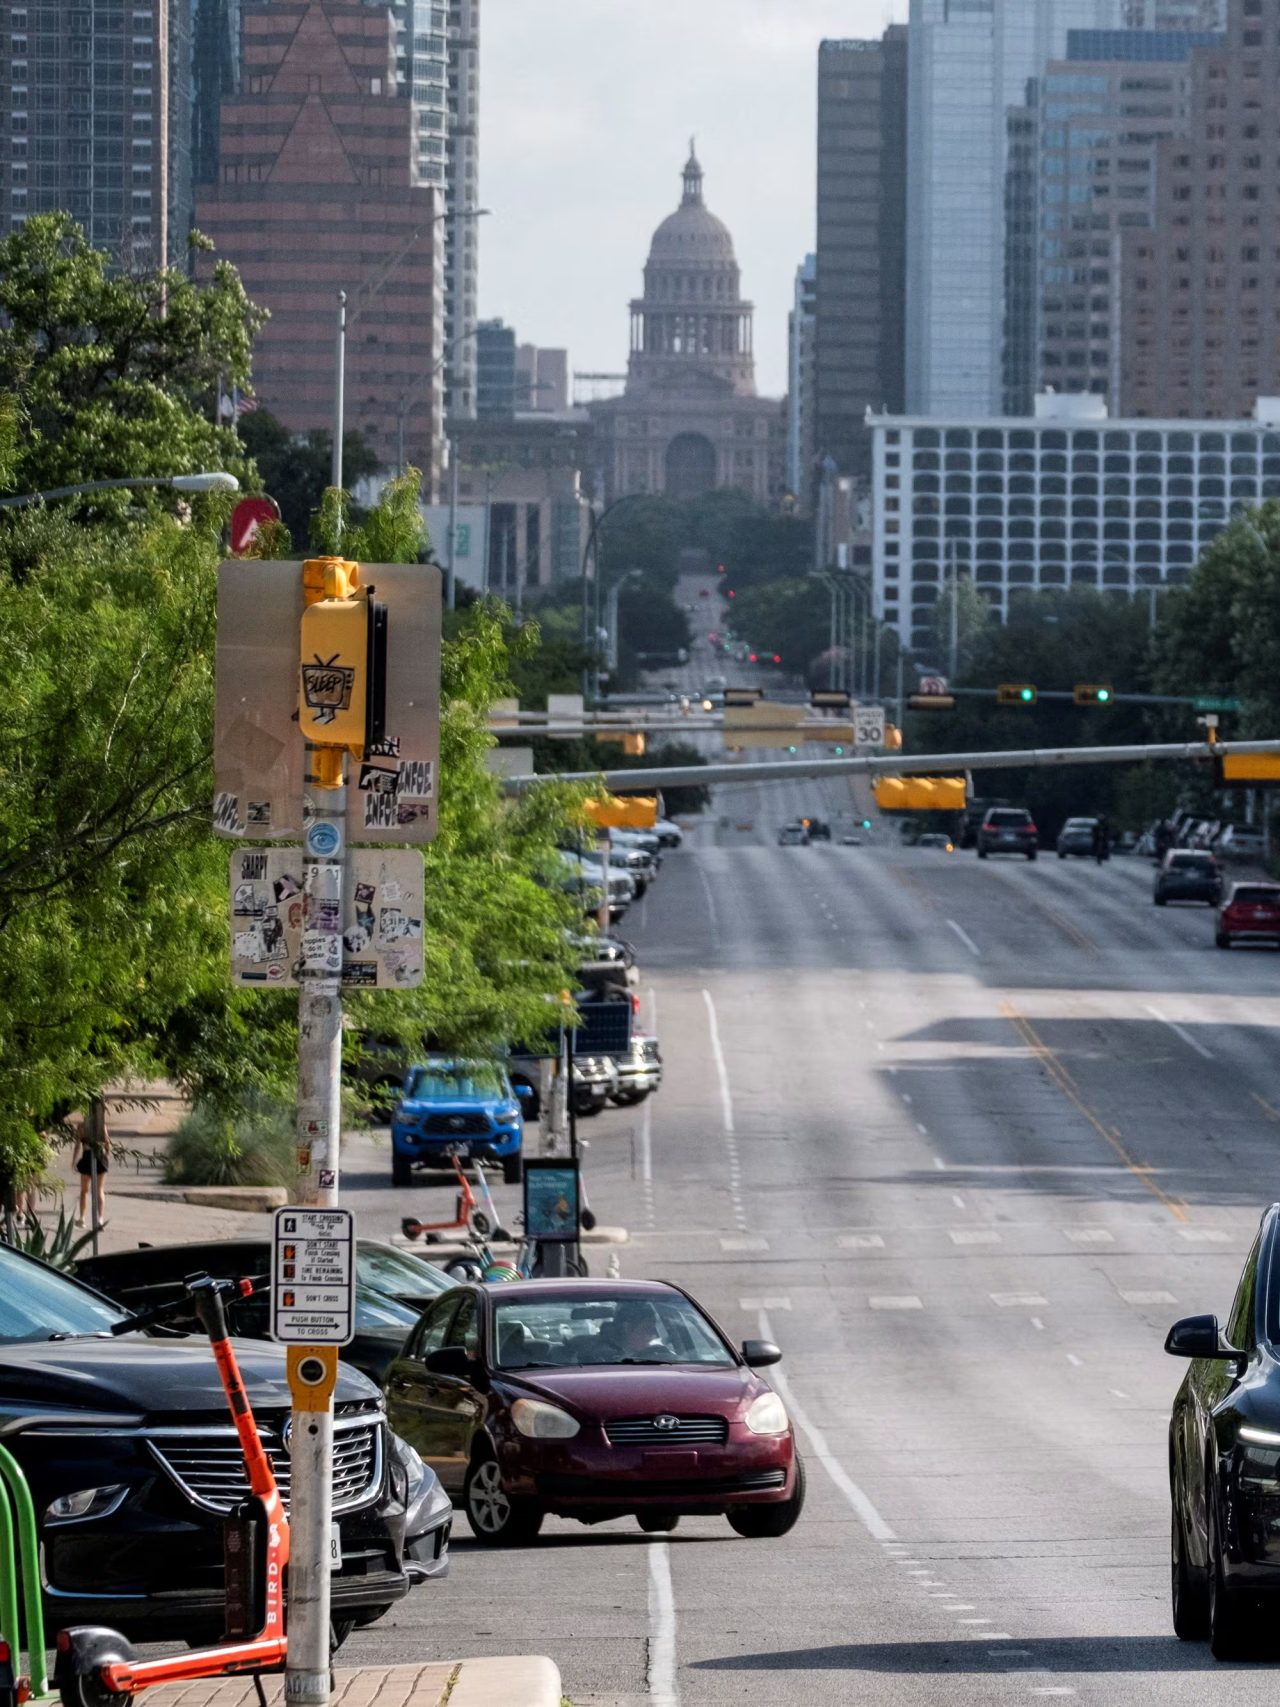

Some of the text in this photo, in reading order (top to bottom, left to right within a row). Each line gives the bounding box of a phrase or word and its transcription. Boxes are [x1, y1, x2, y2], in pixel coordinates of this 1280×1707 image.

[307, 673, 342, 693] SLEEP
[859, 727, 882, 741] 30
[268, 1562, 278, 1623] BIRD
